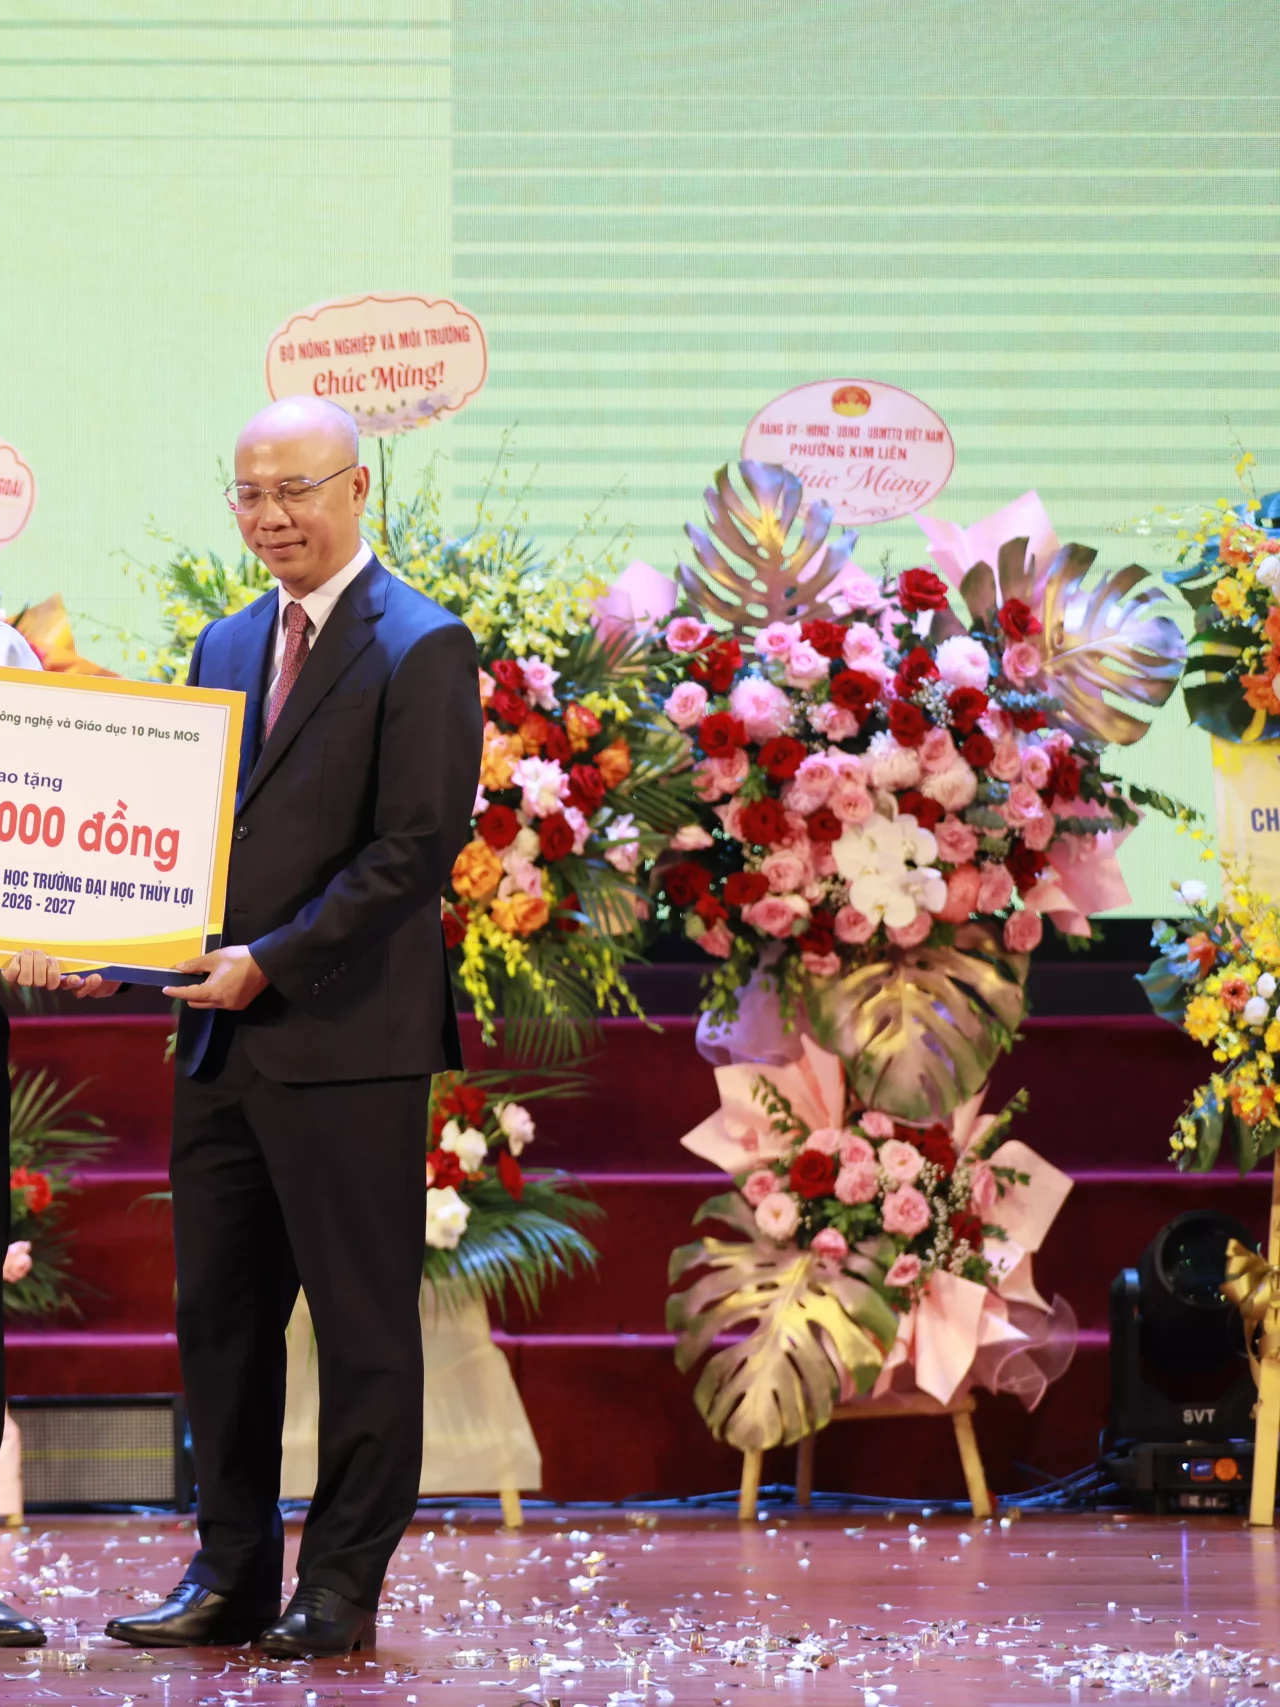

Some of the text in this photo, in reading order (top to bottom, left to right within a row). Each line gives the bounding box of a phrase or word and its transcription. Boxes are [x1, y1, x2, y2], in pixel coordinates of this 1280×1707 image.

[279, 323, 470, 364] BỘ NÔNG NGHIỆP VÀ MÔI TRƯỜNG
[313, 361, 445, 396] Chúc Mừng!
[905, 426, 922, 444] VIỆT
[925, 429, 944, 443] NAM
[849, 445, 874, 459] KIM
[878, 445, 907, 460] LIÊN
[847, 462, 932, 503] Mừng
[24, 715, 53, 729] nghệ
[57, 718, 71, 728] và
[74, 719, 102, 732] Giáo
[105, 723, 127, 736] dục
[131, 725, 145, 737] 10
[147, 727, 170, 739] Plus
[173, 730, 200, 742] MOS
[24, 772, 63, 792] tặng
[77, 798, 181, 873] đồng
[3, 869, 29, 890] HỌC
[33, 871, 83, 893] TRƯỜNG
[85, 878, 107, 898] ĐẠI
[110, 881, 136, 902] HỌC
[139, 880, 171, 903] THỦY
[173, 887, 194, 908] LỢI
[1, 892, 33, 911] 2026
[44, 897, 76, 915] 2027
[1182, 1408, 1216, 1424] SVT
